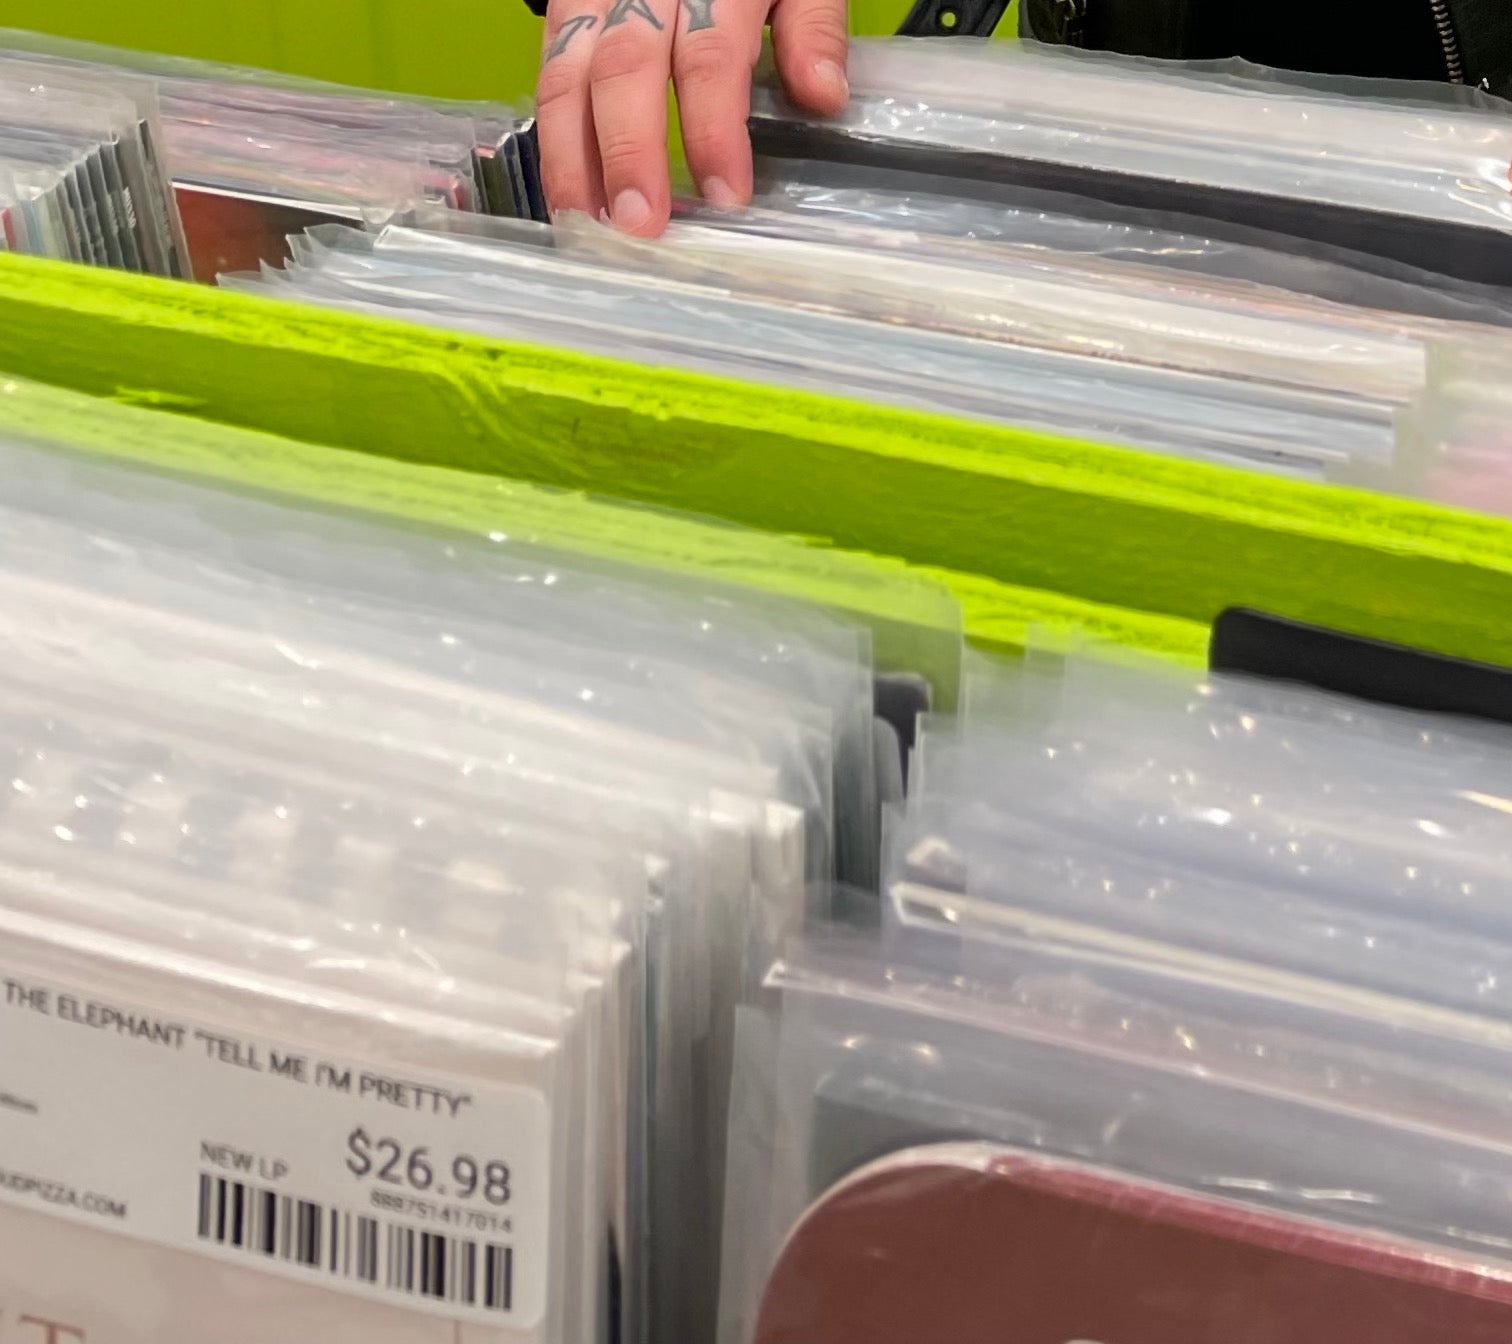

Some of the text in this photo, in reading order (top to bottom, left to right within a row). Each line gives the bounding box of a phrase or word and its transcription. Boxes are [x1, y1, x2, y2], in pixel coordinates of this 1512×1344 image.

[4, 979, 472, 1119] THE ELEPHANT "TELL ME I'M PRETTY"
[200, 1141, 289, 1181] NEW LP
[345, 1127, 512, 1208] $26.98
